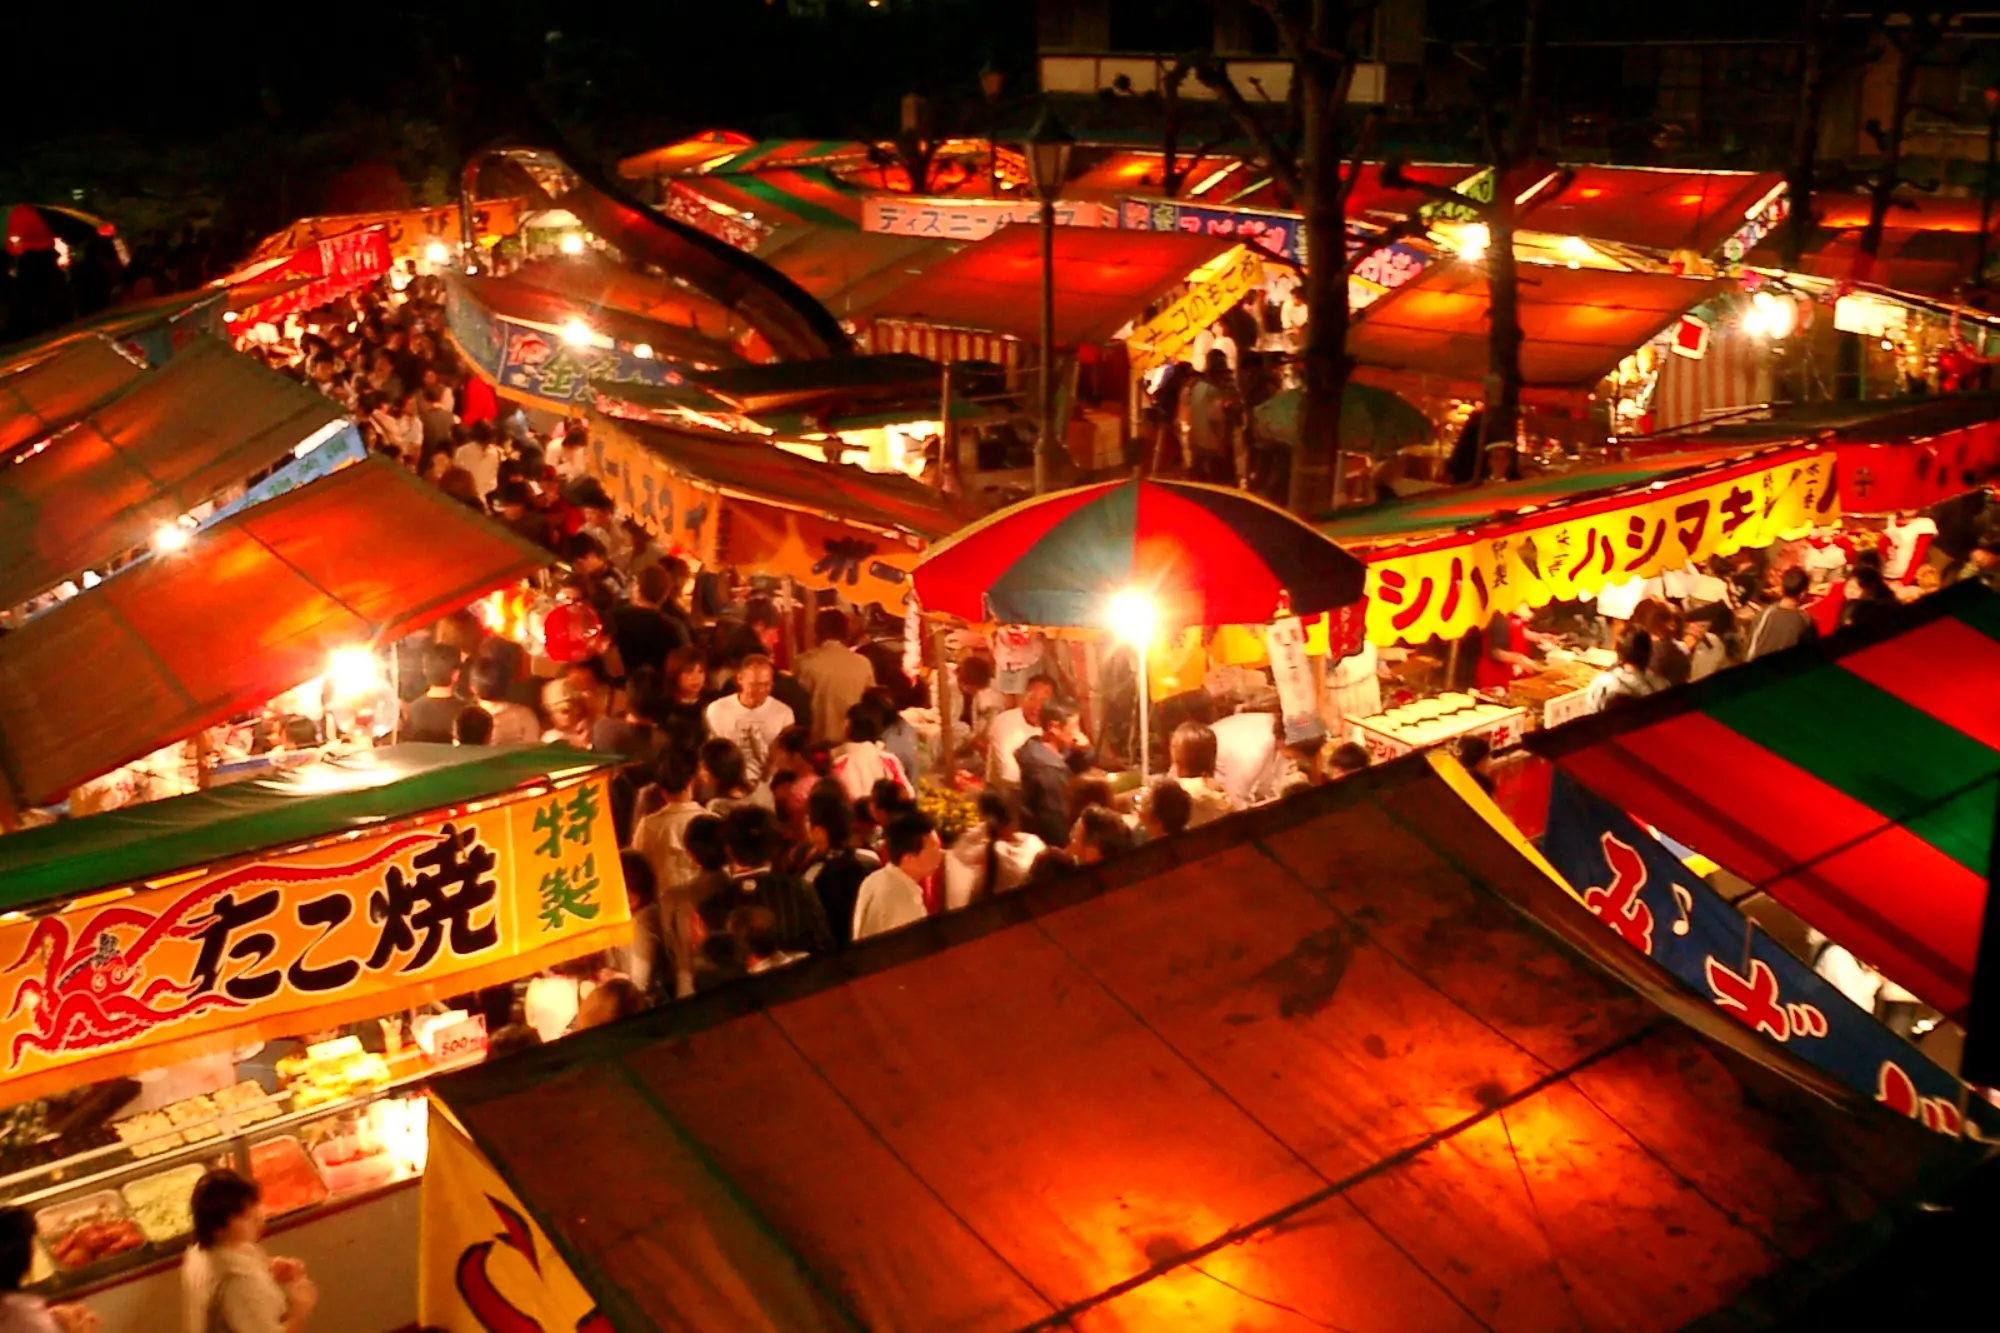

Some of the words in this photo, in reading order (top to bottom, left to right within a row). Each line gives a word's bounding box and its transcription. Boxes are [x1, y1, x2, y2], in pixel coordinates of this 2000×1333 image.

[1567, 485, 1757, 584] ハシマキ
[186, 821, 500, 1001] たこ焼
[531, 783, 600, 933] 特製
